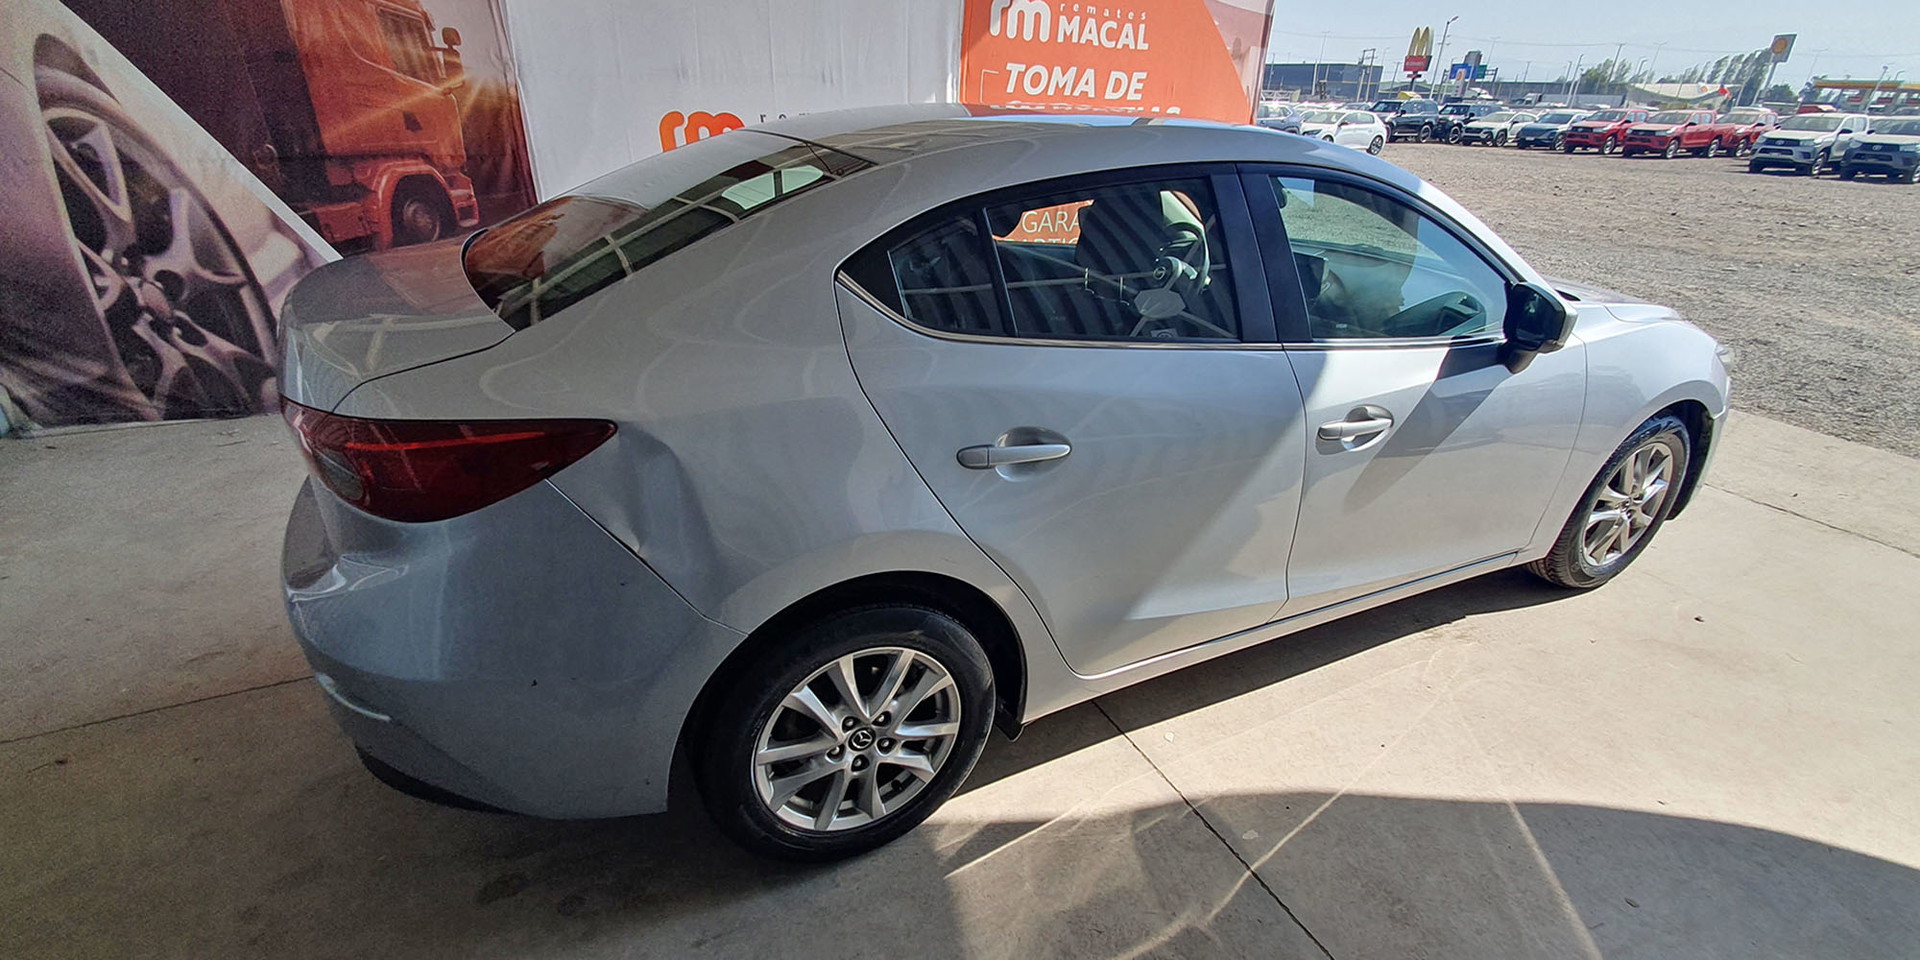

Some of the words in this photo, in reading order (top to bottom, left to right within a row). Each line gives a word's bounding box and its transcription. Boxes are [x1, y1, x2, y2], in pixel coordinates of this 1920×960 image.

[1060, 3, 1146, 20] remates
[1057, 15, 1149, 50] MACAL
[1005, 63, 1096, 98] TOMA
[1104, 71, 1148, 101] DE
